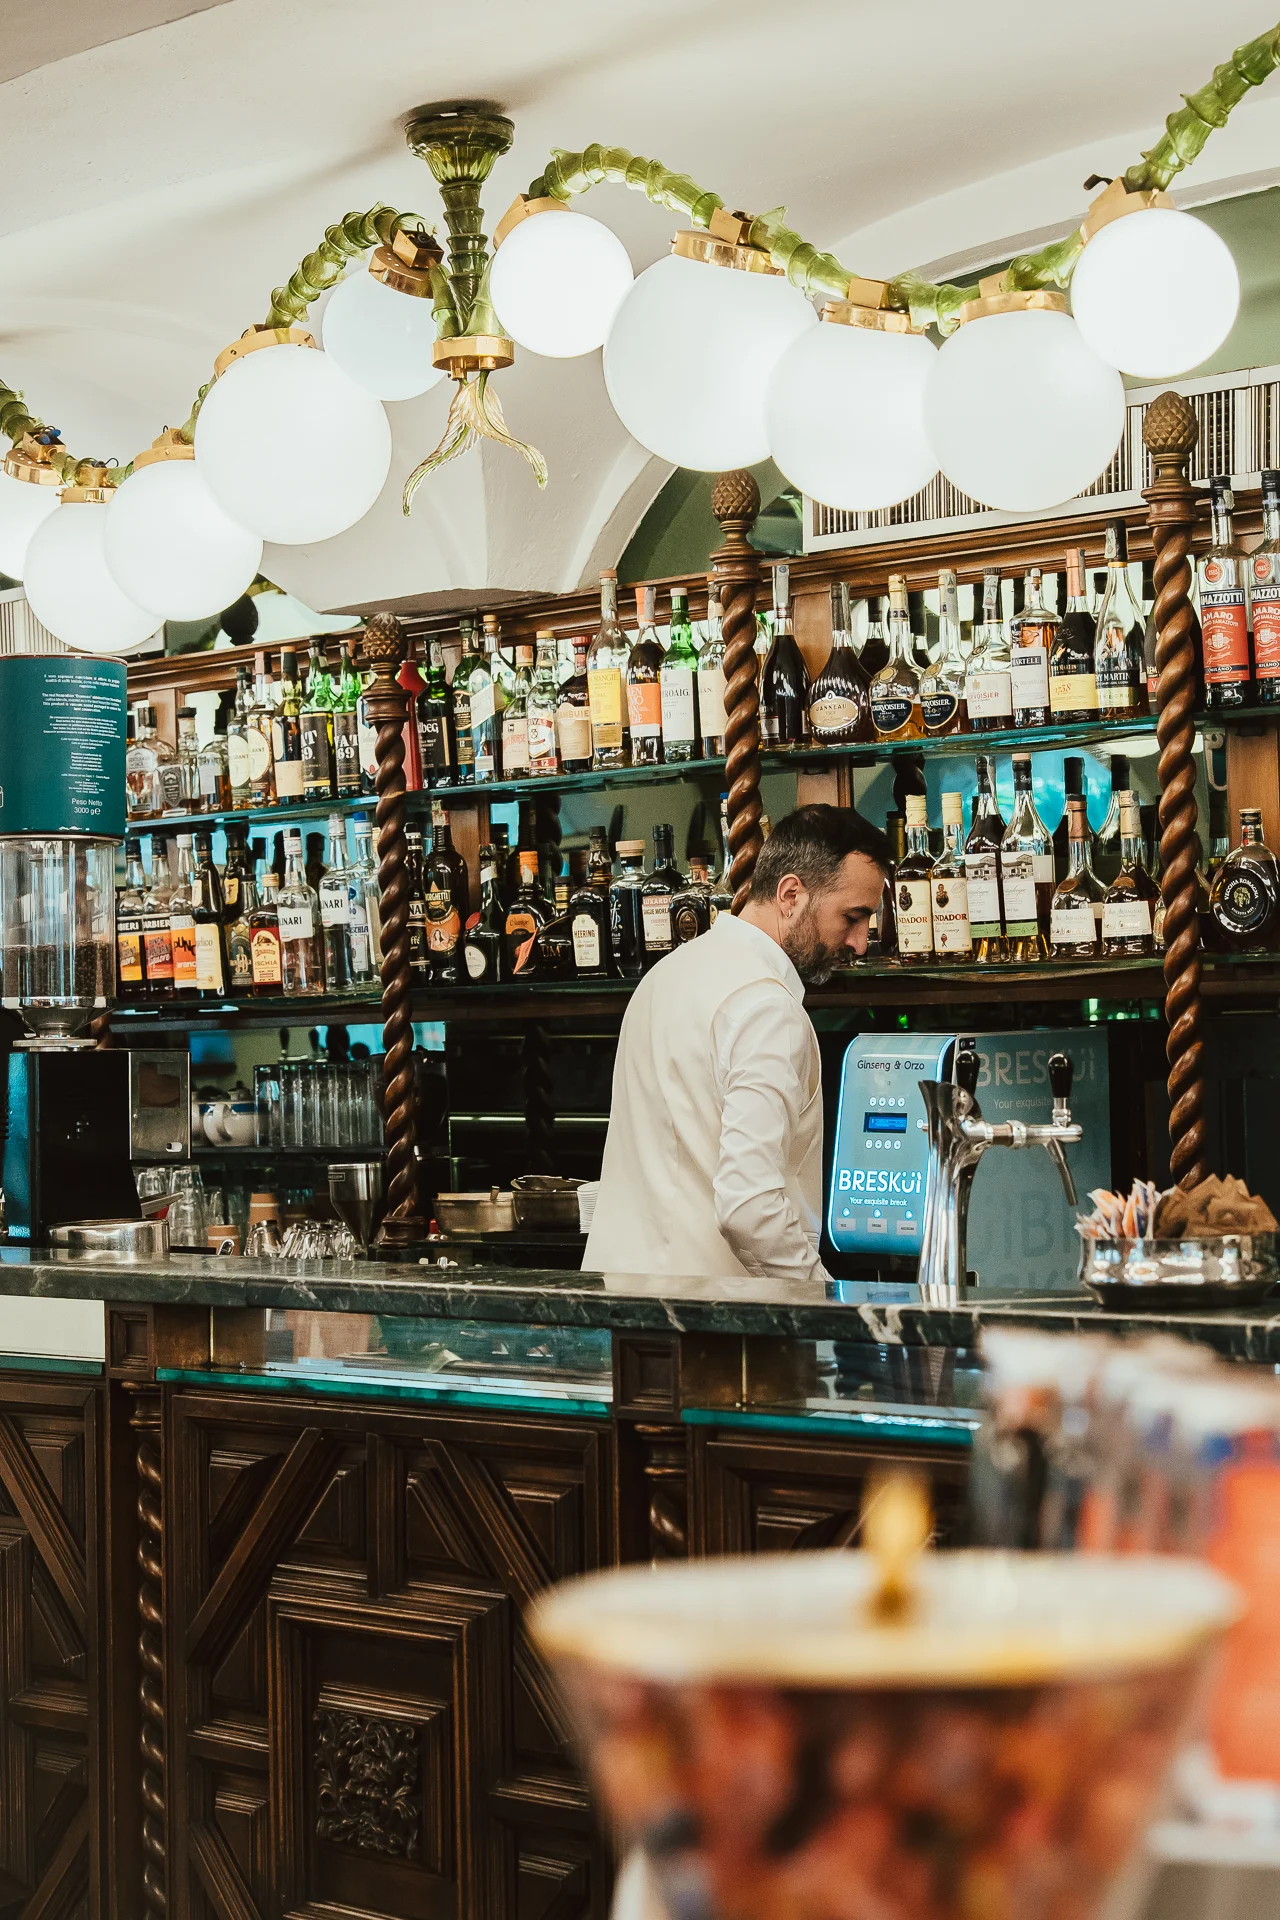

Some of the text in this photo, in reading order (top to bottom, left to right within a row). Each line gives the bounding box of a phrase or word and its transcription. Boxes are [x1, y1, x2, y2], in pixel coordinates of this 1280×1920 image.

[1203, 611, 1233, 623] AMARO
[1104, 671, 1130, 681] MARTIN
[1055, 683, 1071, 695] 1738
[815, 703, 847, 712] JANNEAU
[337, 747, 355, 760] 69
[88, 799, 103, 807] Netto
[73, 806, 89, 814] 3000
[1224, 878, 1259, 900] VECCHIA ROMAGNA
[934, 913, 967, 922] NDADOR
[574, 929, 595, 938] HEERING
[857, 1060, 925, 1072] Ginseng & Orzo
[994, 1096, 1051, 1109] Your exquisite
[864, 1198, 888, 1206] exquisite
